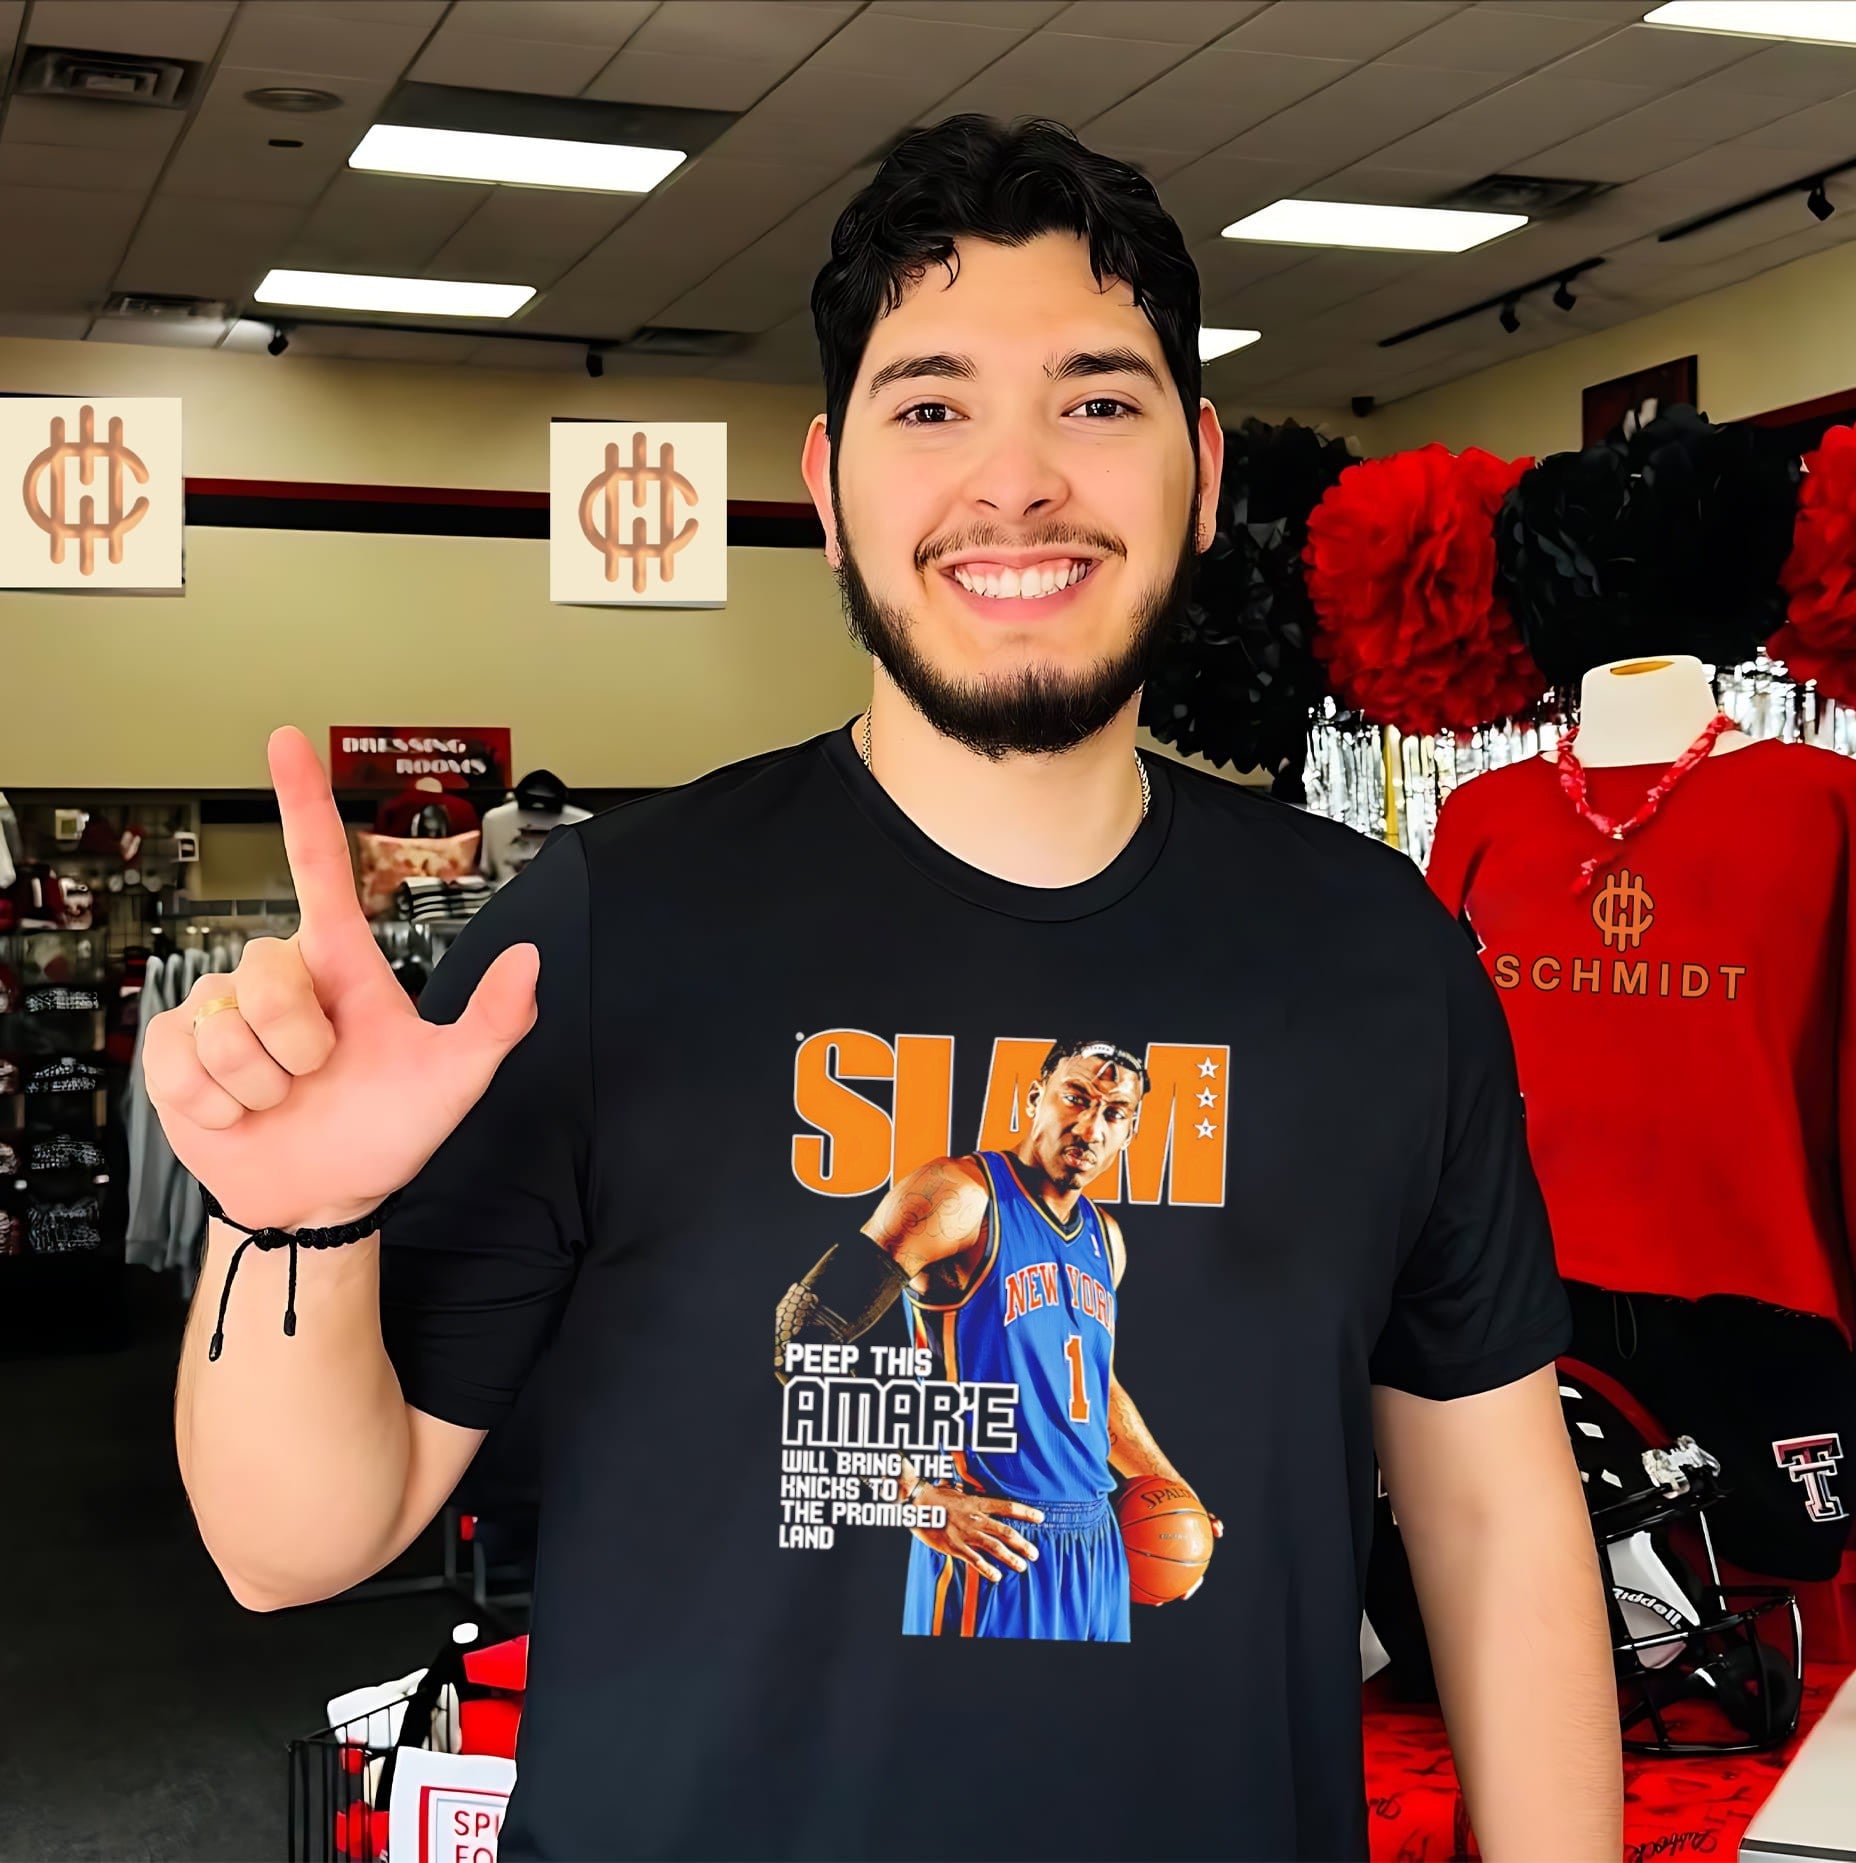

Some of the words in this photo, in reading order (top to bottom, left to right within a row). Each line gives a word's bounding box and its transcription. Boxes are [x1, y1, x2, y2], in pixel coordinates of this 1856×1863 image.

[342, 737, 467, 754] DRESSING
[396, 758, 487, 775] ROOMS
[1494, 954, 1746, 1000] SCHMIDT
[791, 1028, 1230, 1207] SLAM
[1004, 1262, 1059, 1327] NEW
[785, 1343, 859, 1373] PEEP
[870, 1346, 933, 1376] THIS
[1064, 1333, 1090, 1423] 1
[782, 1375, 1019, 1453] AMAR'E
[782, 1450, 829, 1475] WILL
[836, 1452, 901, 1477] BRING
[910, 1455, 953, 1478] THE
[780, 1475, 860, 1500] KNICKS
[870, 1477, 898, 1501] TO
[780, 1501, 824, 1525] THE
[832, 1502, 946, 1528] PROMISED
[779, 1526, 834, 1549] LAND
